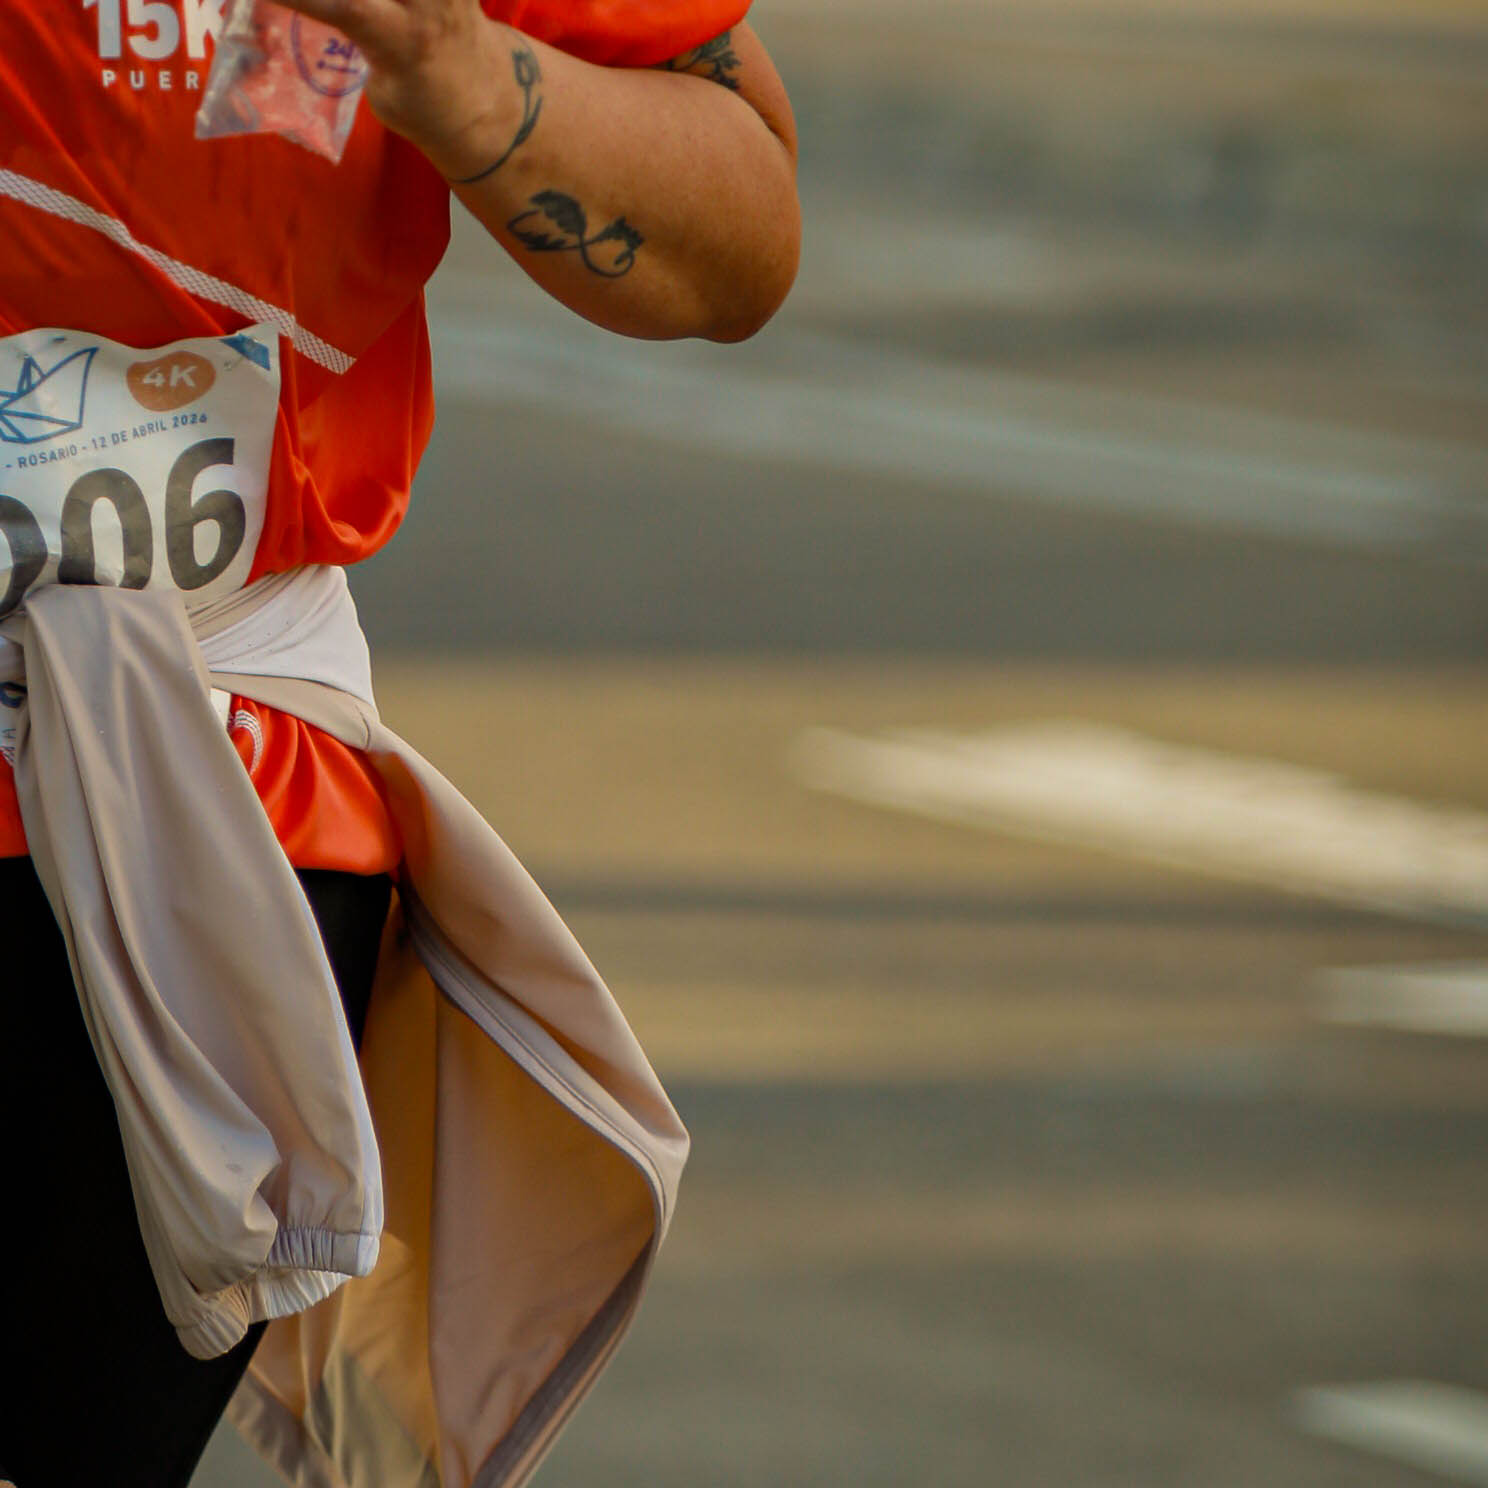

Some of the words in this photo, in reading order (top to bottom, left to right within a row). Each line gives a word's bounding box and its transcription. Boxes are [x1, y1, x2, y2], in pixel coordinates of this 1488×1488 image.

[101, 68, 200, 91] PUER
[143, 364, 198, 388] 4K
[17, 444, 78, 469] ROSARIO
[91, 436, 107, 450] 12
[111, 429, 128, 446] DE
[132, 419, 167, 440] ABRIL
[172, 412, 208, 428] 2026
